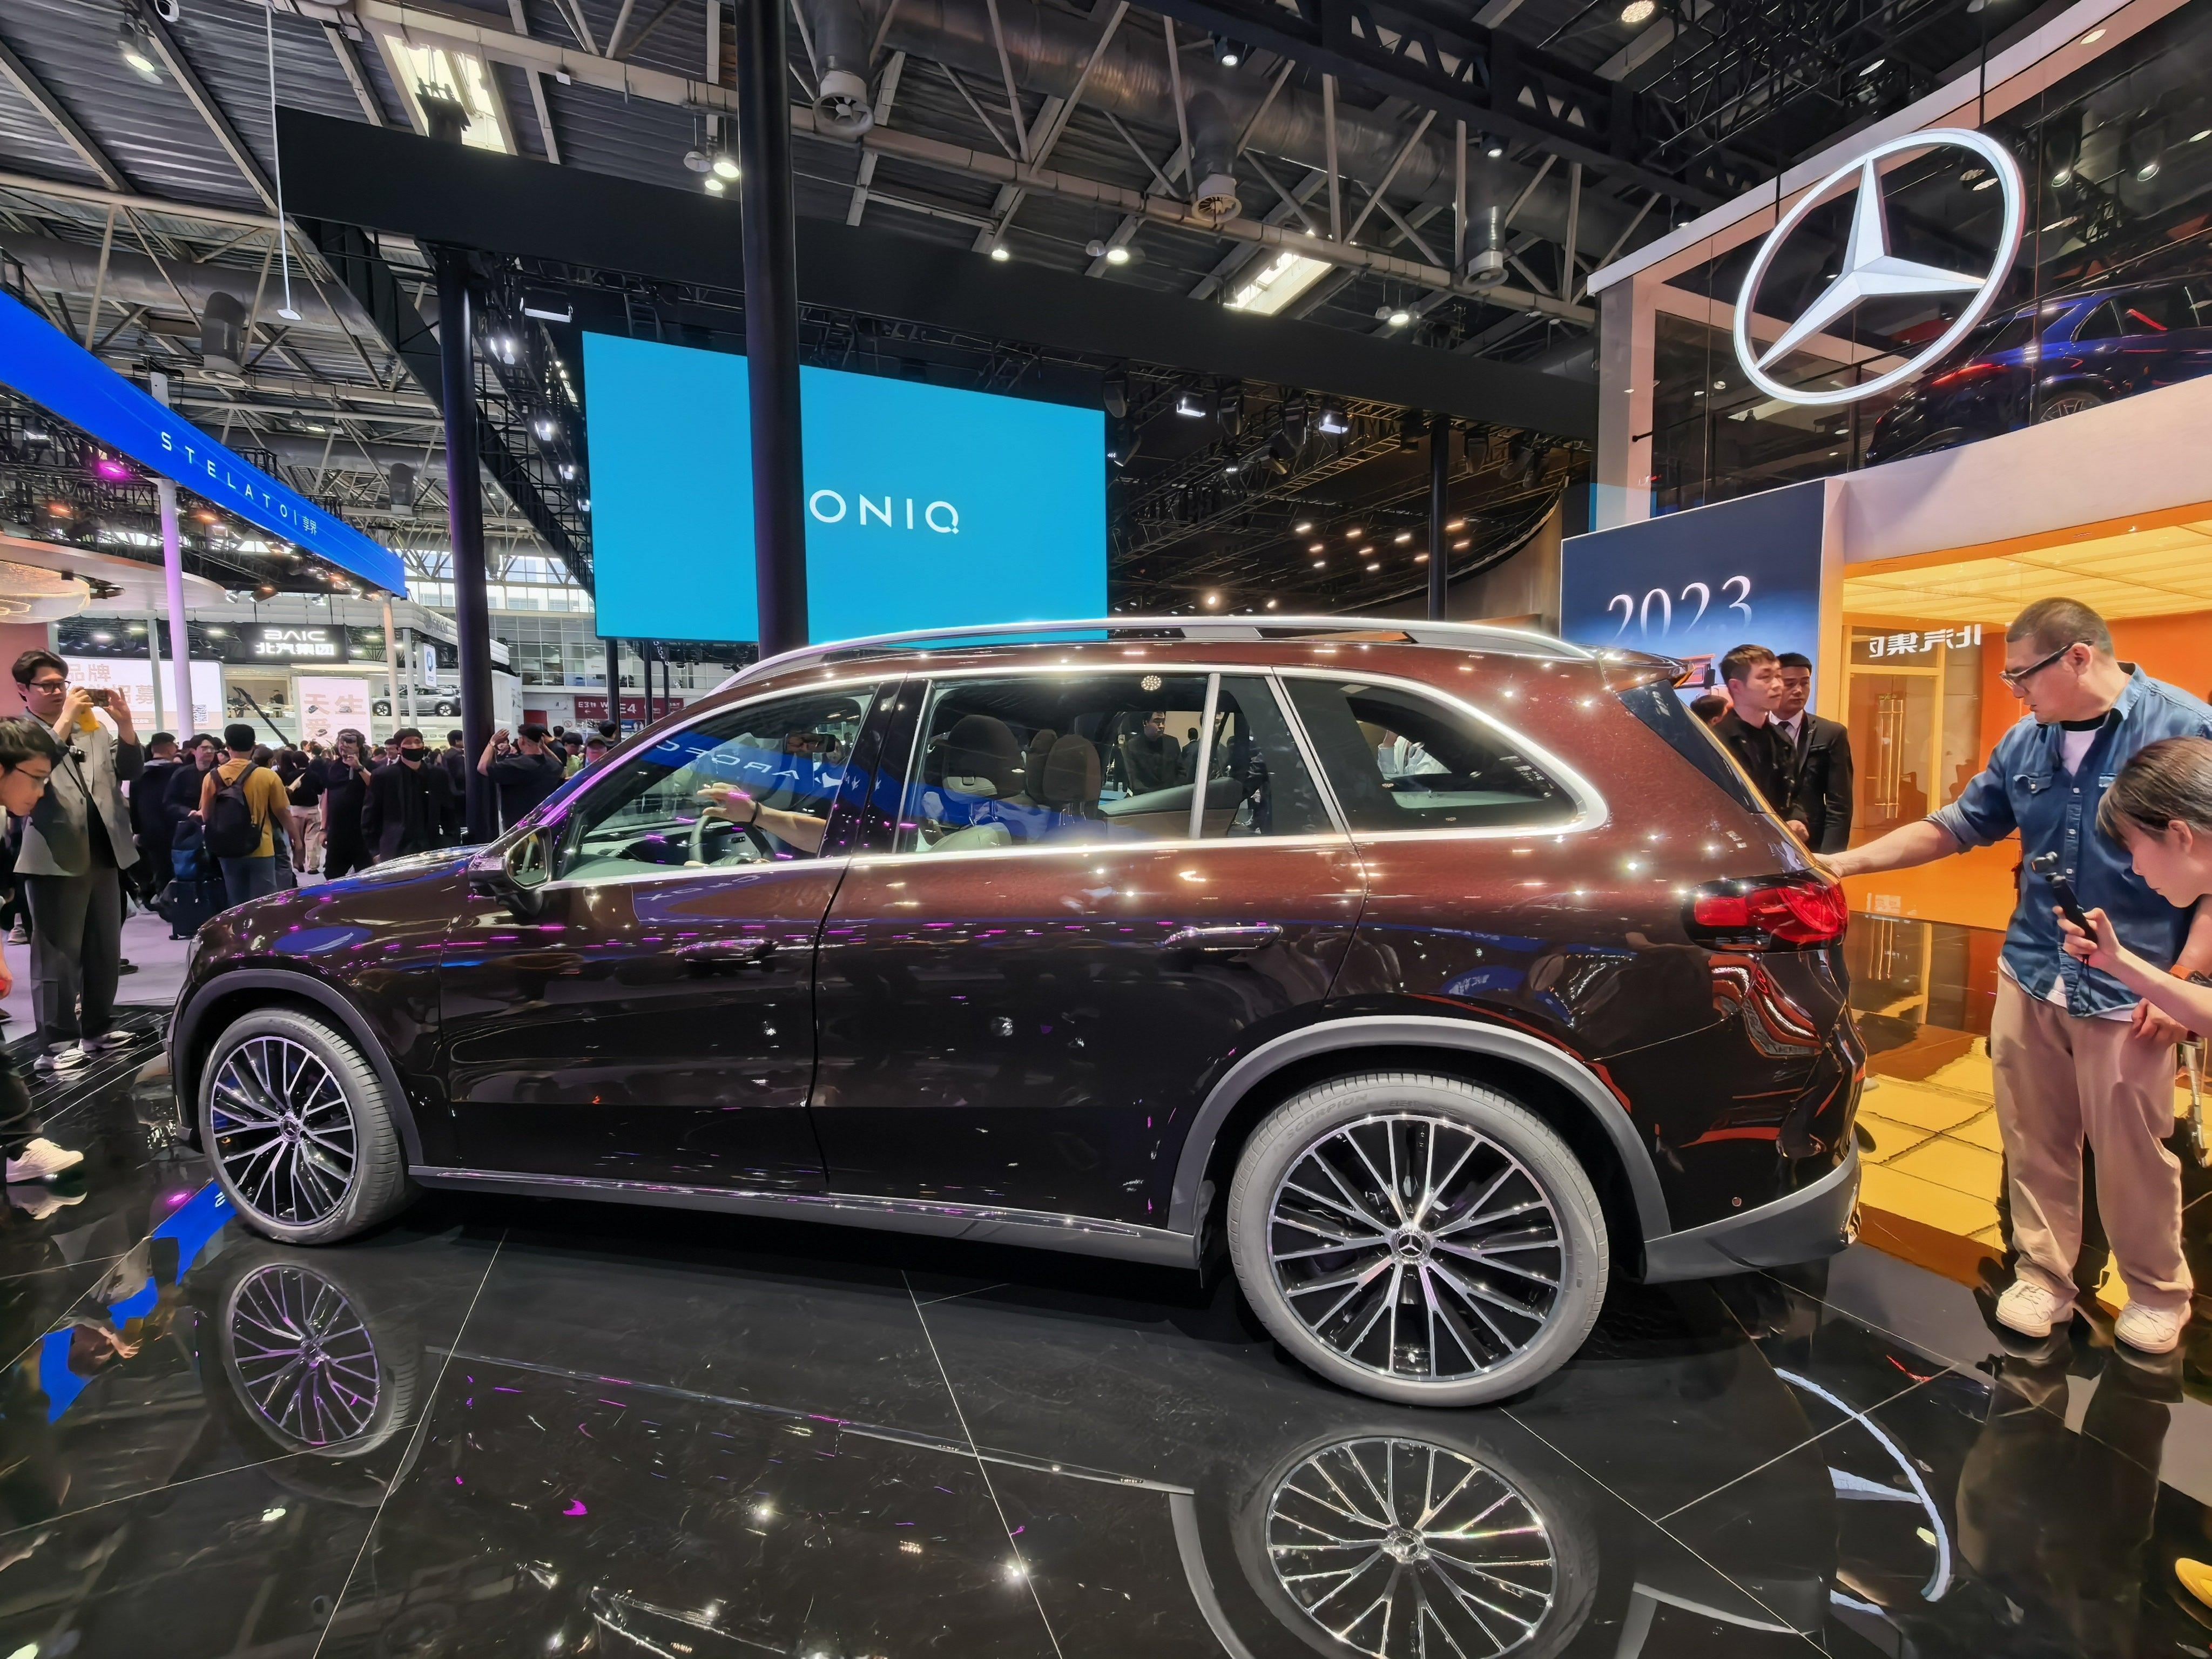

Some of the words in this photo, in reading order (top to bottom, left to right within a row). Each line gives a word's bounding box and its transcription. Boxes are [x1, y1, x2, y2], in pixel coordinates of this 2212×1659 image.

[161, 431, 288, 518] STELATO
[302, 515, 318, 536] 享界
[1607, 575, 1752, 642] 2023
[264, 629, 326, 642] BAIC
[304, 693, 366, 716] 天生
